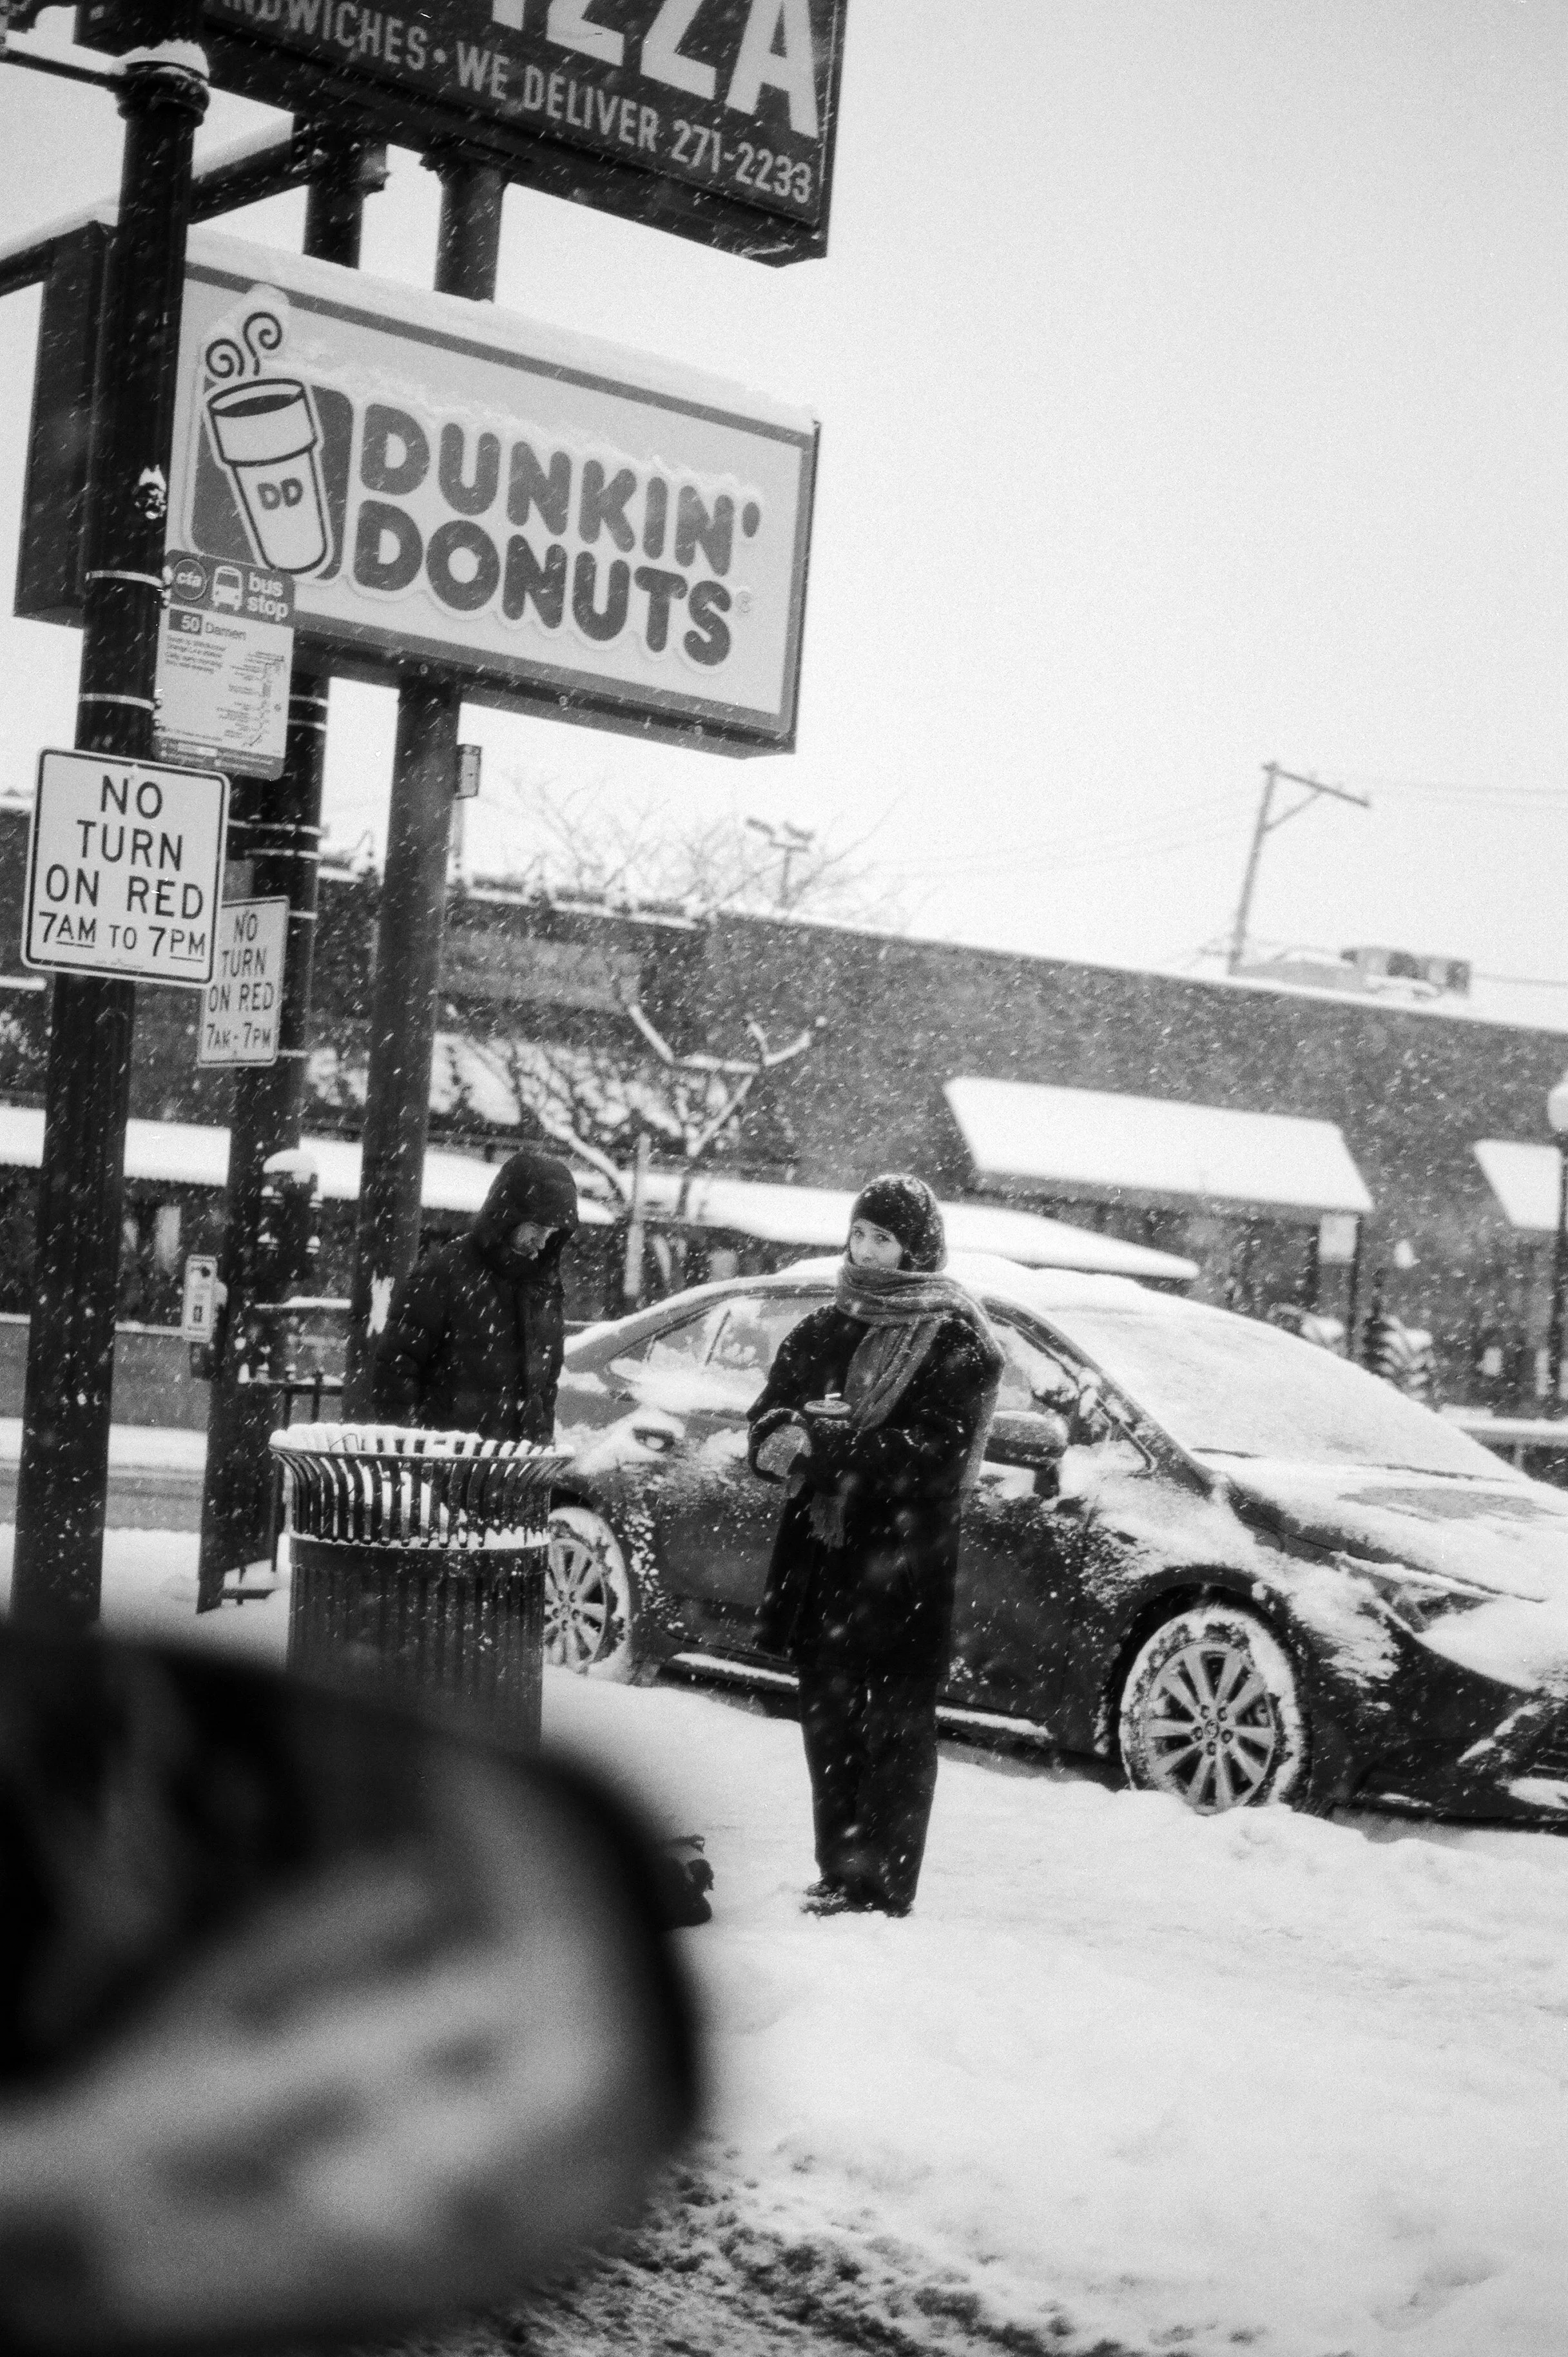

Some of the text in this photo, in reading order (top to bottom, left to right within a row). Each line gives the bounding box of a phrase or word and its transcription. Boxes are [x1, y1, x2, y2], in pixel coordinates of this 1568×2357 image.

[456, 41, 510, 100] WE
[522, 64, 659, 153] DELIVER
[670, 119, 812, 204] 271-2233
[257, 478, 303, 510] DD
[360, 403, 761, 577] DUNKIN'
[249, 572, 284, 597] bus
[353, 499, 732, 667] DONUTS
[181, 614, 200, 632] 50
[247, 595, 289, 622] stop
[100, 775, 163, 819] NO
[77, 819, 183, 871] TURN
[45, 864, 204, 920] ON RED
[39, 911, 206, 963] 7AM TO 7PM
[233, 911, 258, 942] NO
[222, 947, 267, 978] TURN
[208, 982, 275, 1013] ON RED
